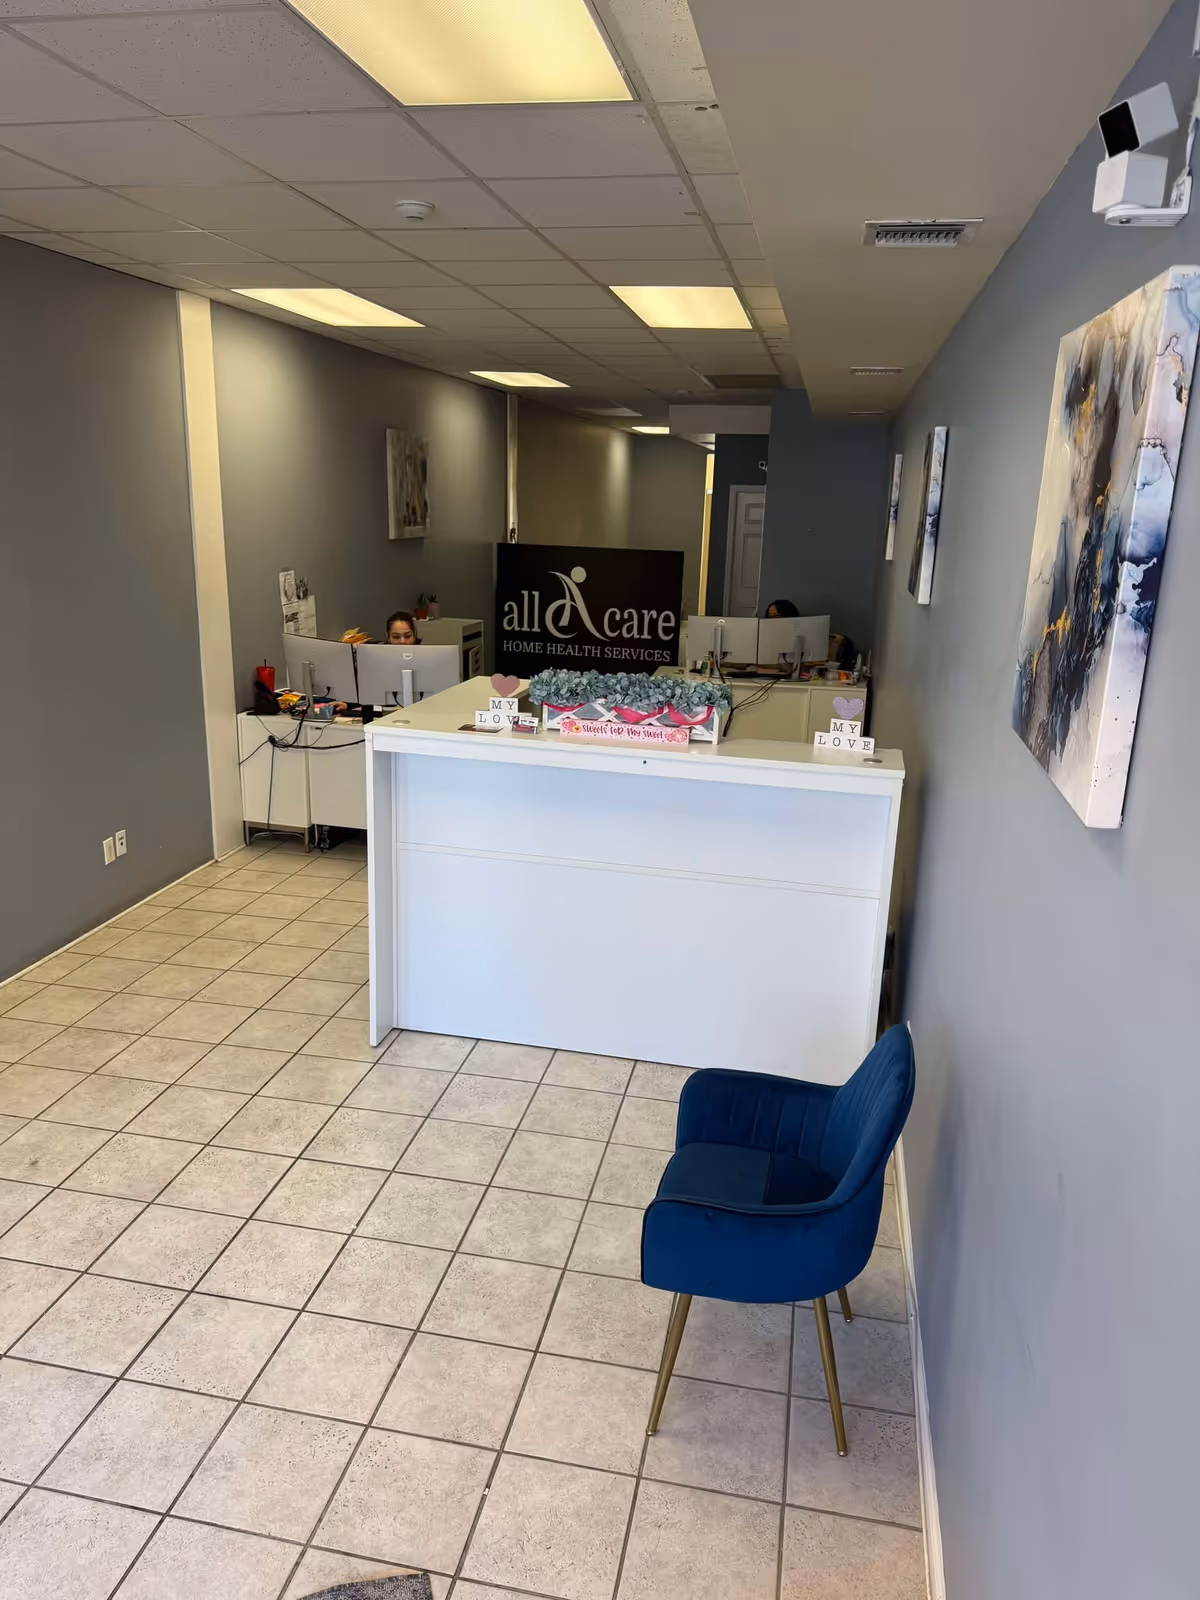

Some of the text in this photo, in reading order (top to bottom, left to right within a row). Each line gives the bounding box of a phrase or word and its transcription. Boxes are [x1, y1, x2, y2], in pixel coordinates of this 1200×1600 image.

[503, 590, 541, 632] all
[603, 607, 676, 641] care
[503, 640, 671, 663] HOME HEALTH SERVICES
[491, 700, 516, 710] MY
[478, 713, 514, 725] LOV
[832, 722, 858, 733] MY
[818, 735, 871, 751] LOVE
